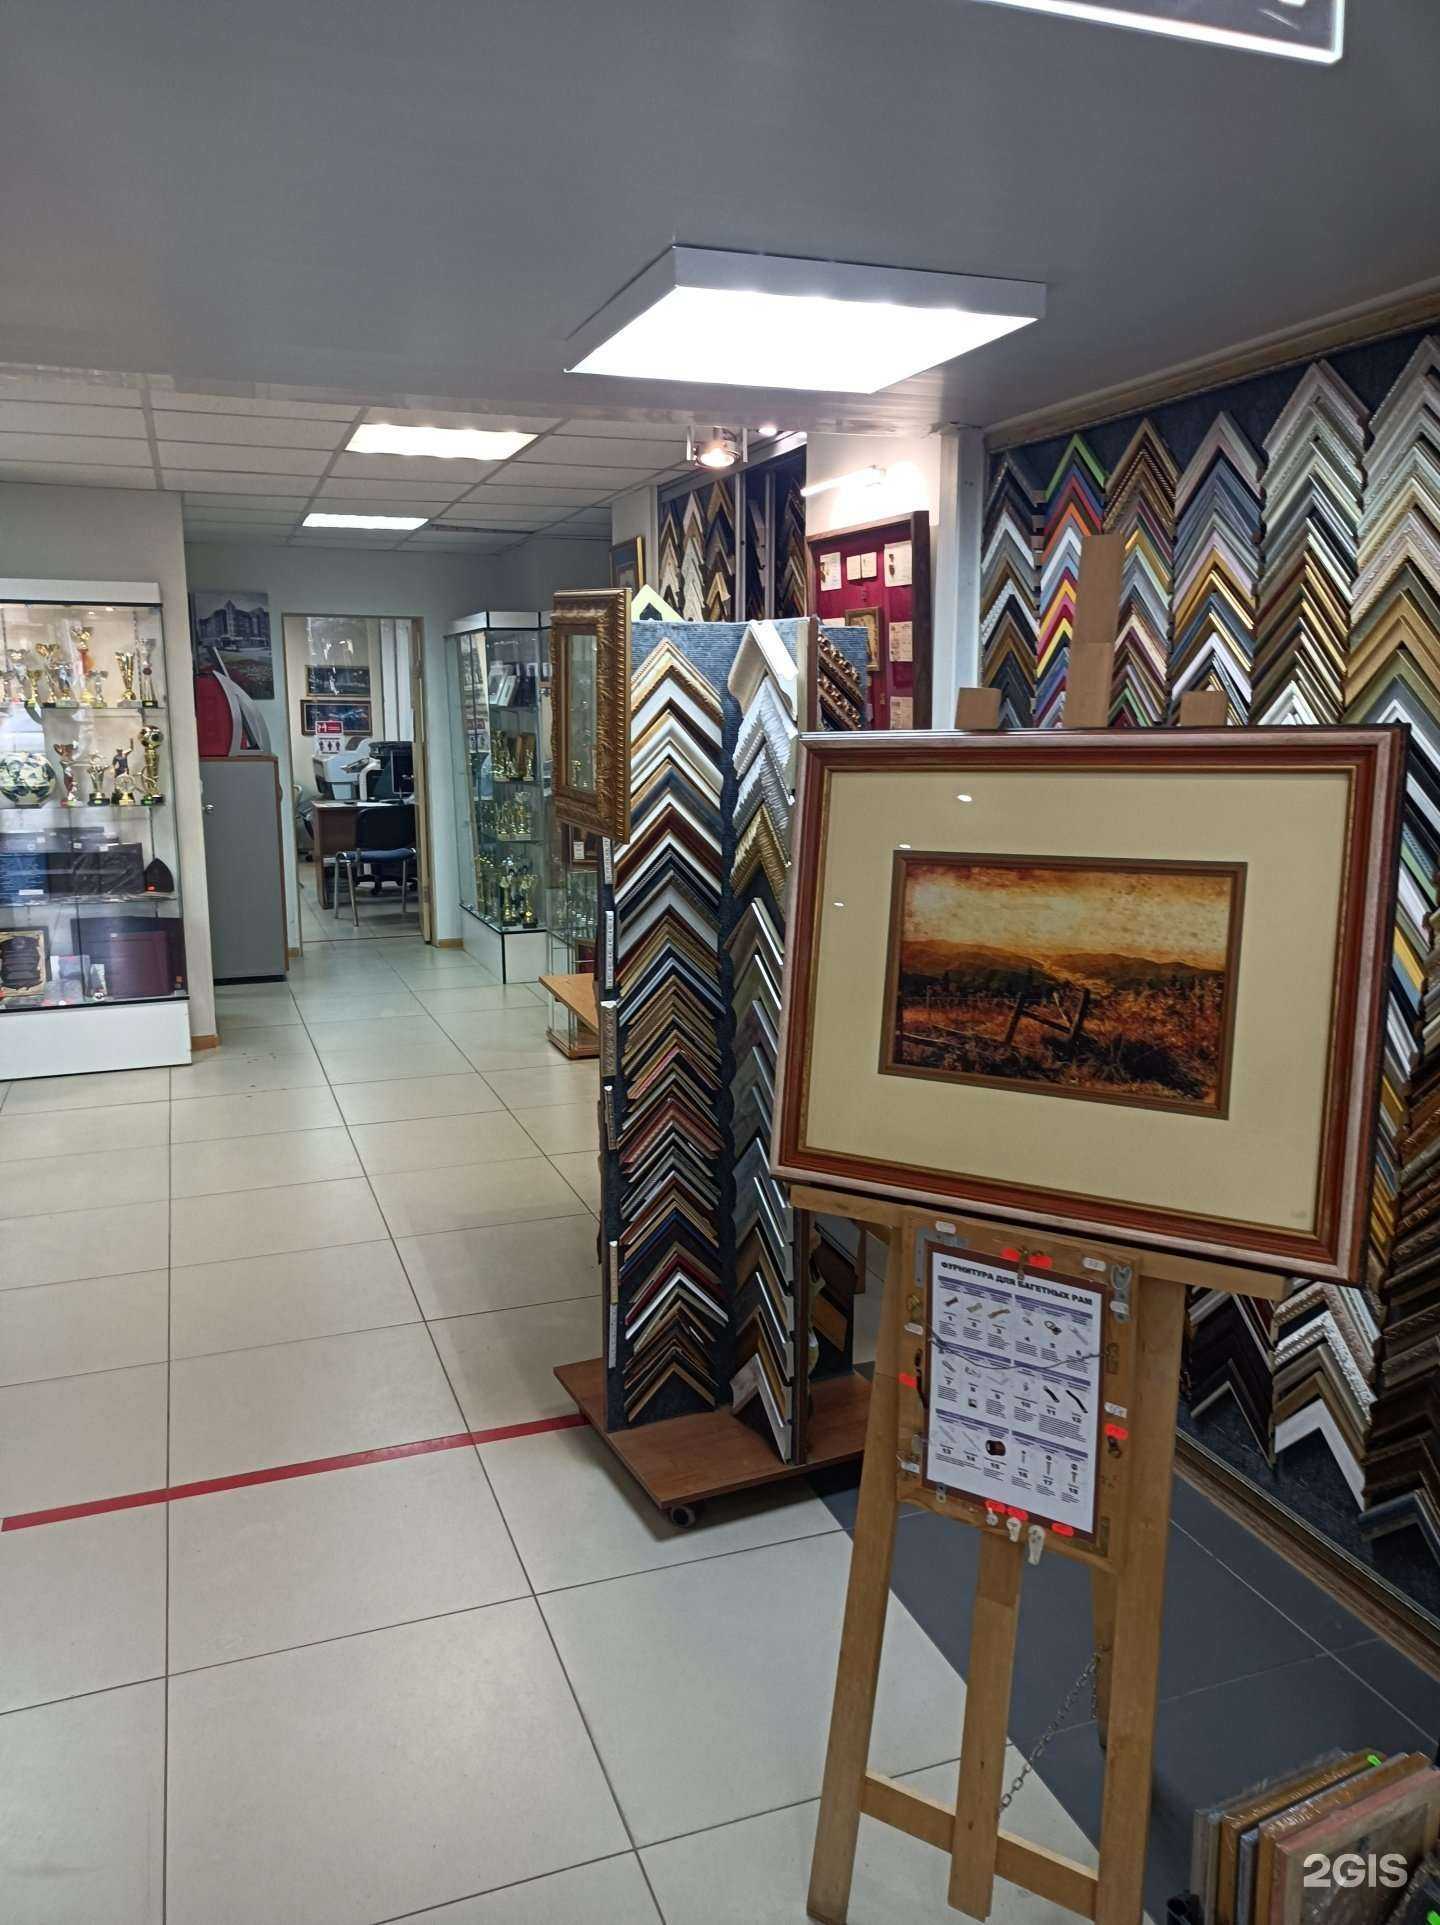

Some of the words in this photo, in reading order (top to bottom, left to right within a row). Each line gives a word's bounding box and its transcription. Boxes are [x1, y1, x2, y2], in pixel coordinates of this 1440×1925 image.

[940, 1261, 995, 1281] ФУРНИТУРА
[995, 1274, 1016, 1287] ДЛЯ
[1017, 1280, 1070, 1300] БАГЕТНЫХ
[1071, 1294, 1094, 1306] РАМ
